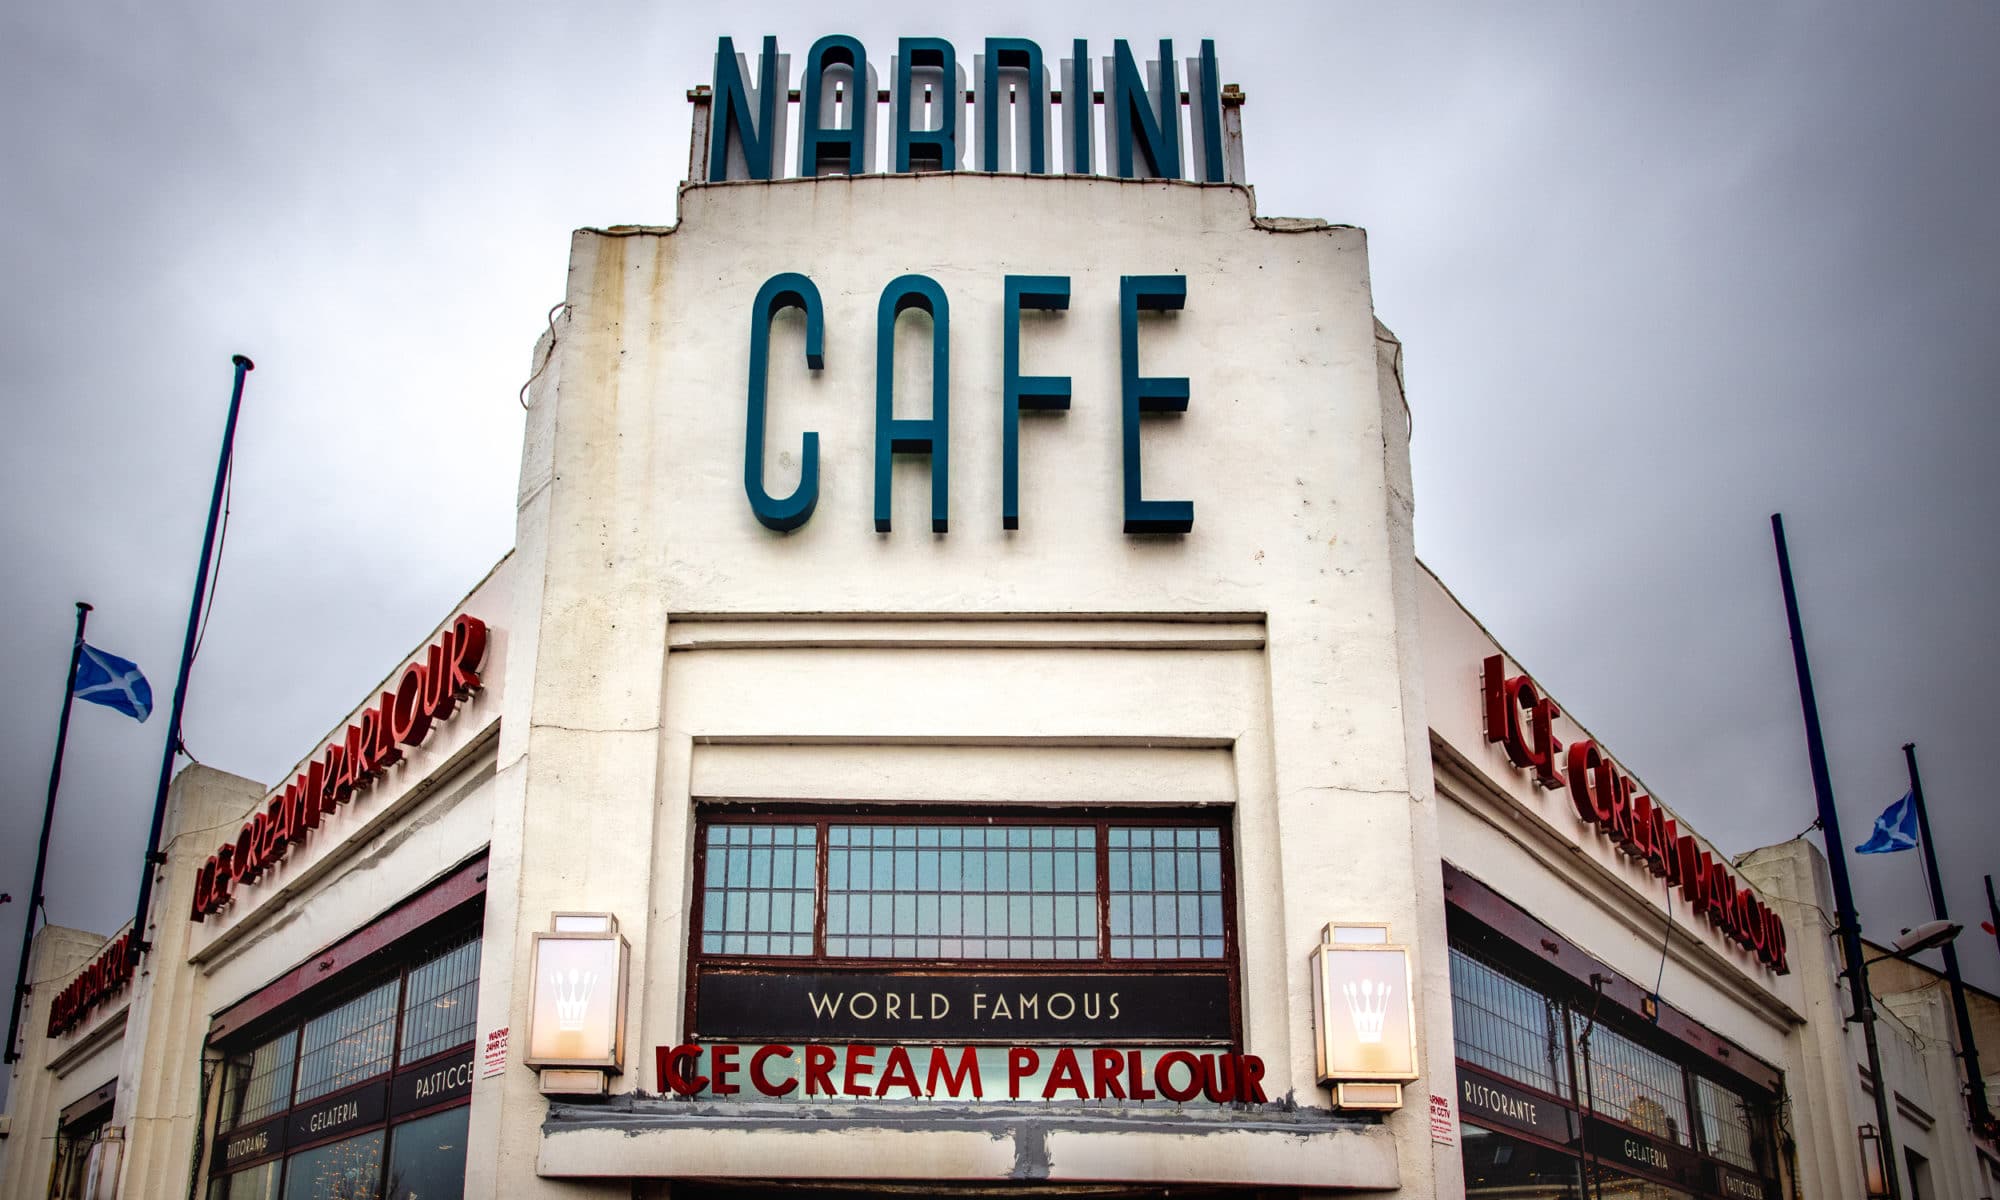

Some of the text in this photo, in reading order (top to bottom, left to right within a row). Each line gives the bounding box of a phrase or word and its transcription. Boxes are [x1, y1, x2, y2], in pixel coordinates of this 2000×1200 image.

[709, 34, 1224, 182] NARDINI
[744, 272, 1194, 533] CAFE
[190, 613, 487, 922] ICE CREAM PARLOUR
[1483, 654, 1790, 976] ICE CREAM PARLOUR
[808, 992, 1120, 1020] WORLD FAMOUS
[416, 1061, 474, 1100] PASTICCE
[1009, 1047, 1269, 1104] PARLOUR
[310, 1101, 359, 1133] GELATERIA
[1464, 1080, 1537, 1125] RISTORANTE
[227, 1131, 269, 1161] RISTORANTE
[1624, 1139, 1669, 1171] GELATERIA
